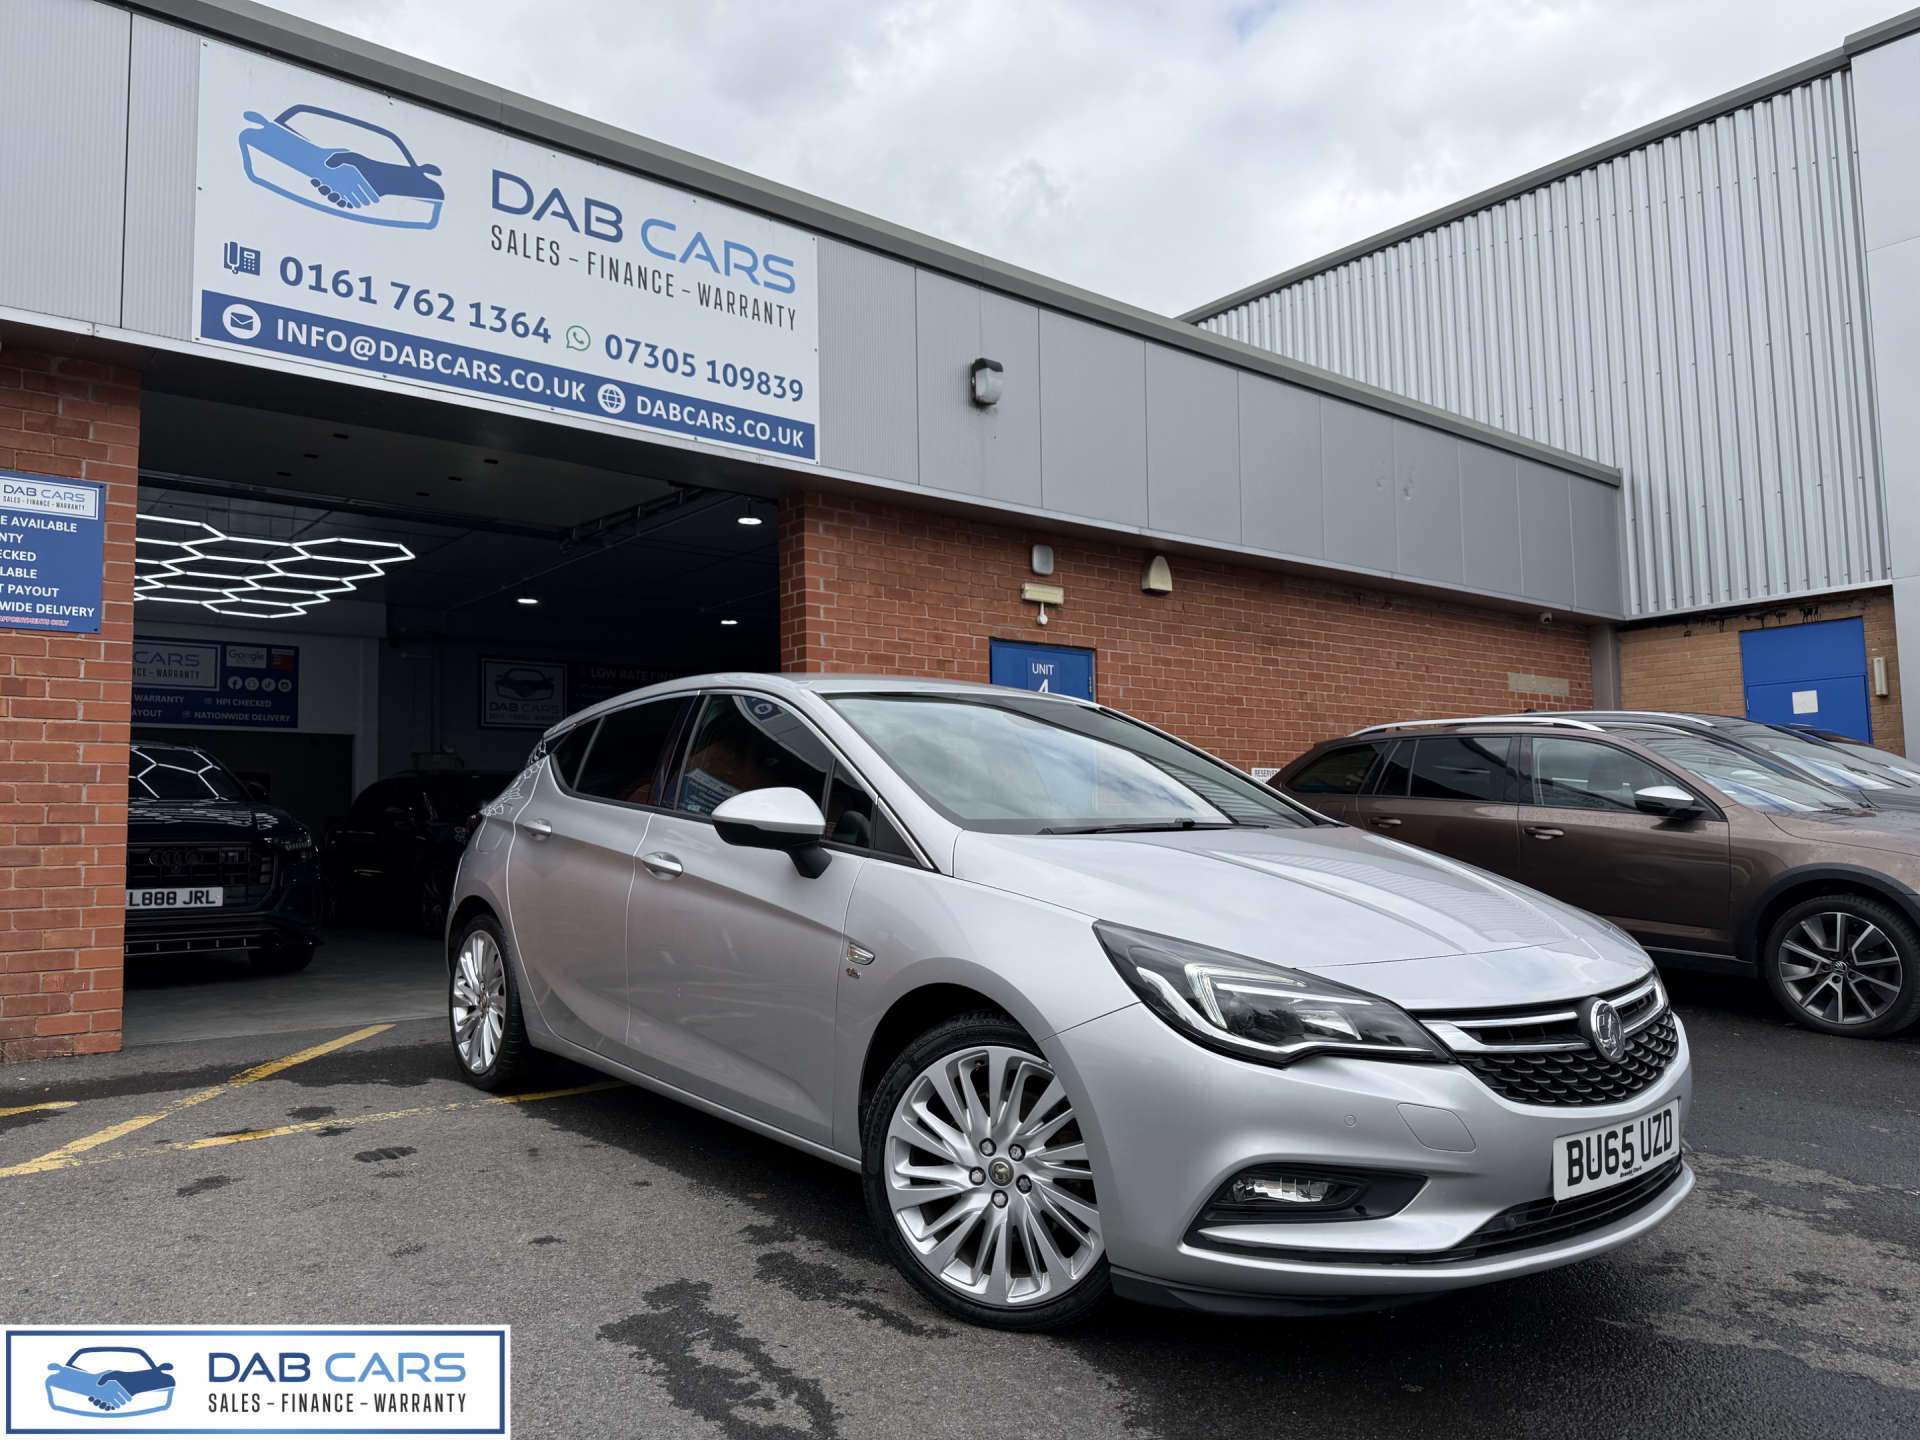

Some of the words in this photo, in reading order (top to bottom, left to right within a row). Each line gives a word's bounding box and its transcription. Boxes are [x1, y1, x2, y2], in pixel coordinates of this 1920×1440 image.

[492, 169, 623, 243] DAB
[641, 217, 796, 294] CARS
[491, 224, 560, 266] SALES
[587, 251, 674, 298] FINANCE
[697, 281, 796, 331] WARRANTY
[280, 256, 378, 305] 0161
[390, 281, 455, 322] 762
[469, 302, 551, 344] 1364
[276, 318, 586, 402] INFO@DABCARS.CO.UK
[605, 334, 697, 377] 07305
[706, 359, 804, 402] 109839
[636, 395, 805, 448] DABCARS.CO.UK
[3, 484, 37, 497] DAB
[41, 489, 86, 503] CARS
[11, 517, 78, 533] AVAILABLE
[8, 584, 60, 598] PAYOUT
[36, 604, 95, 617] DELIVERY
[1032, 662, 1055, 676] UNIT
[134, 694, 185, 704] WARRANTY
[232, 699, 272, 708] CHECKED
[193, 711, 250, 721] NATIONWIDE
[252, 713, 291, 723] DELIVERY
[129, 891, 177, 907] L888
[182, 889, 216, 906] JRL
[1566, 1124, 1634, 1187] BU65
[1641, 1108, 1673, 1162] UZD
